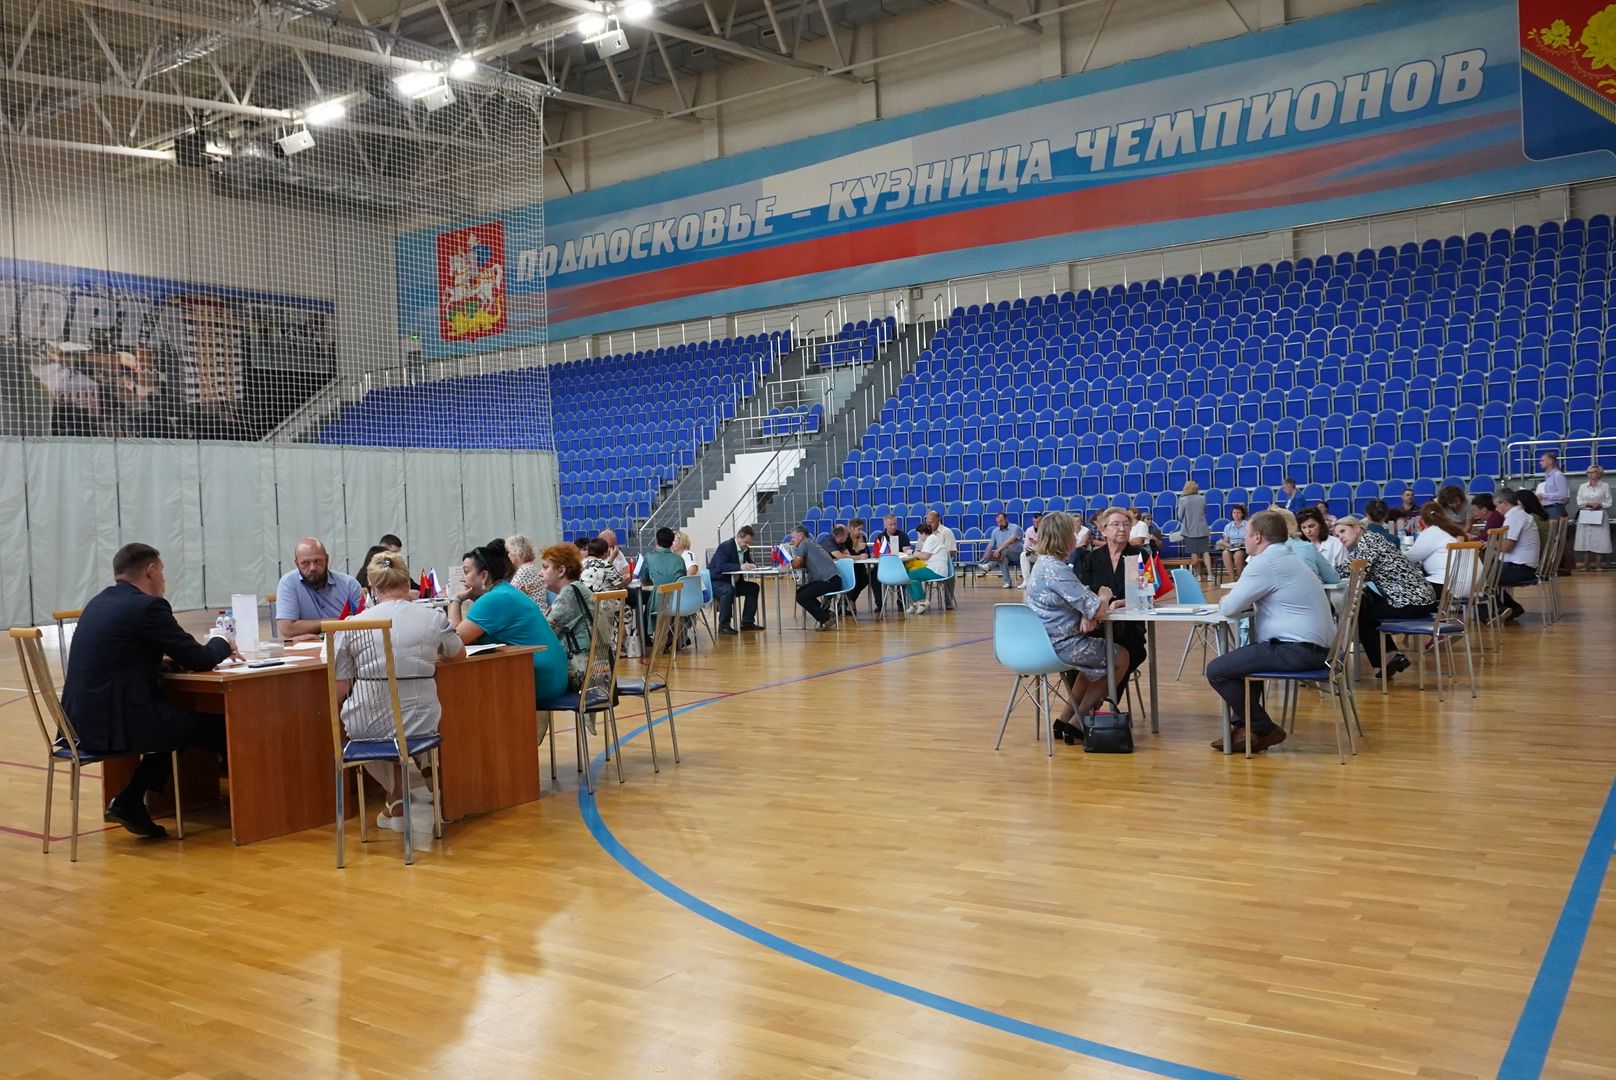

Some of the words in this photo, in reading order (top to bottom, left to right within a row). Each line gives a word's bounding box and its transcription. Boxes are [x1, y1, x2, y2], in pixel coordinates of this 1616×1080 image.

[516, 196, 777, 282] ПОДМОСКОВЬЕ
[827, 139, 1055, 222] КУЗНИЦА
[1075, 48, 1487, 172] ЧЕМПИОНОВ
